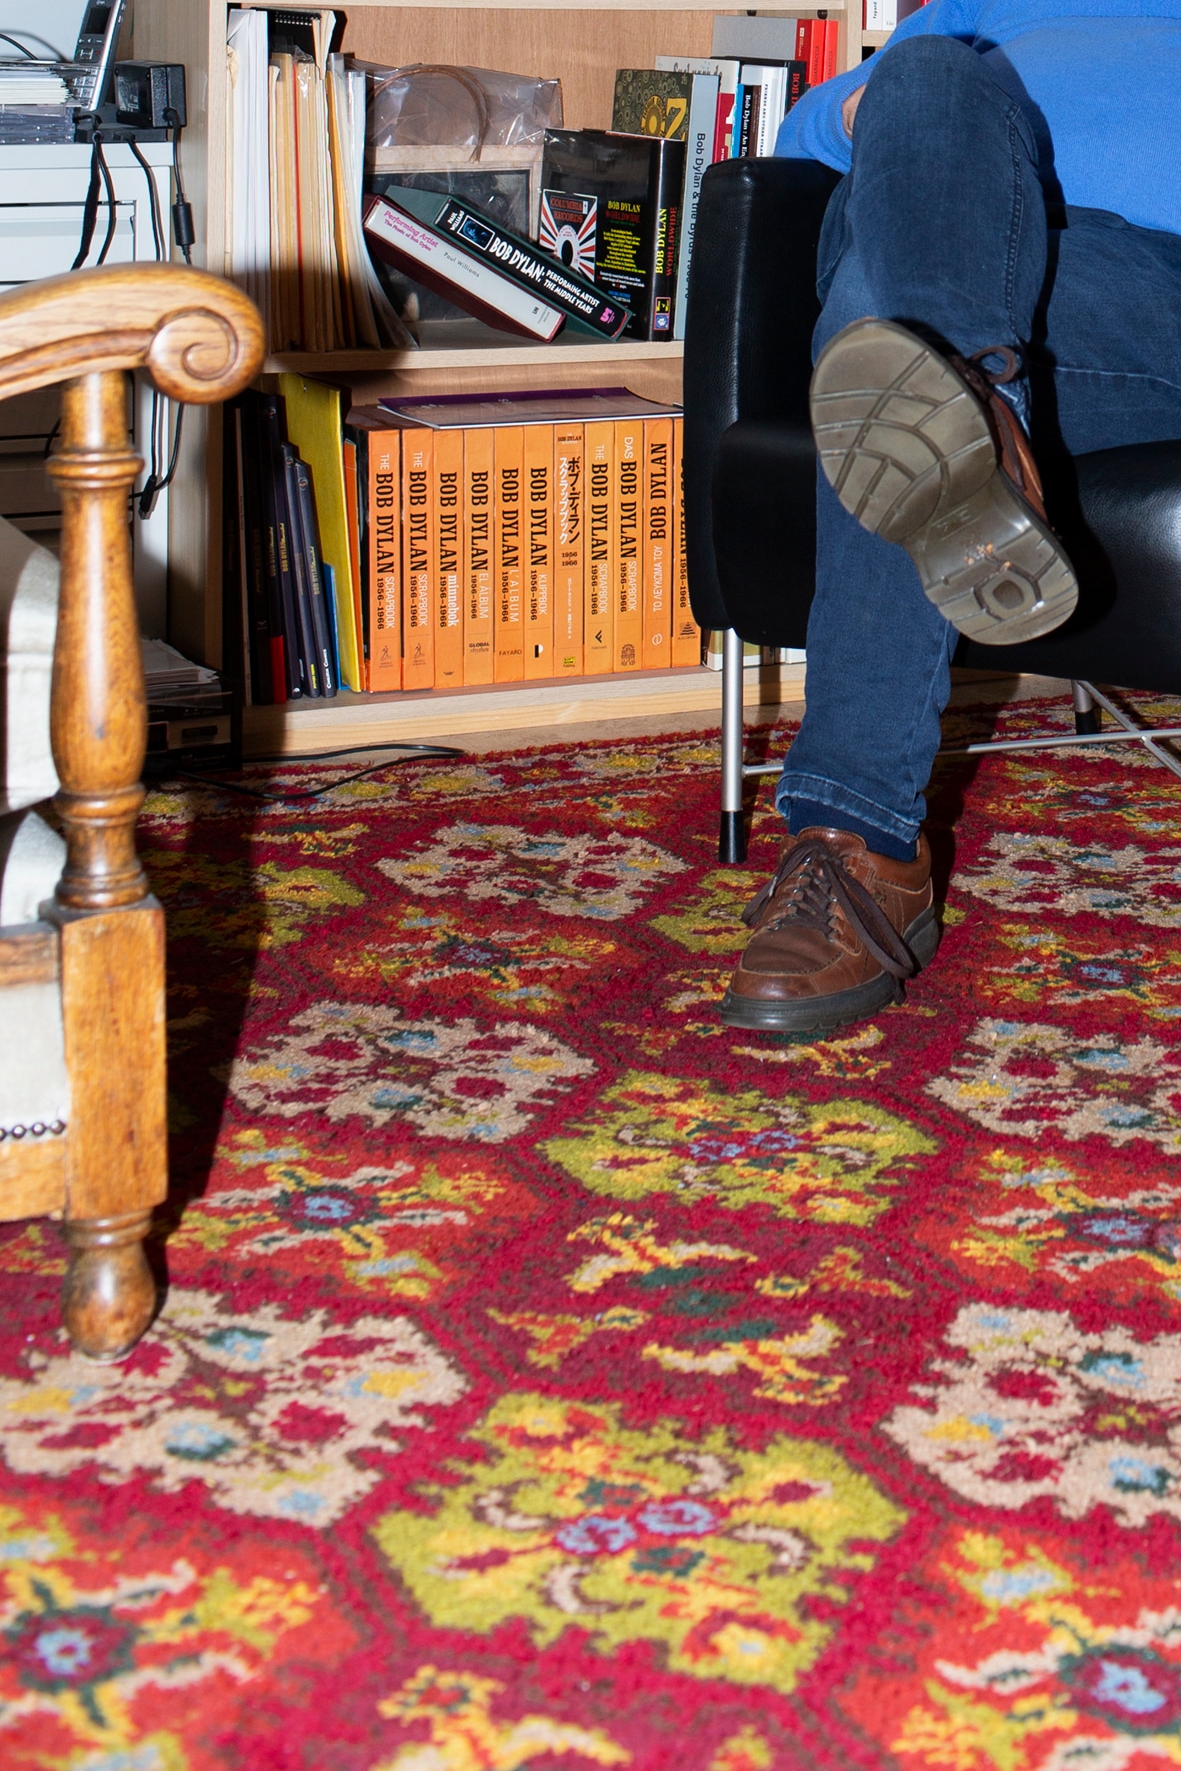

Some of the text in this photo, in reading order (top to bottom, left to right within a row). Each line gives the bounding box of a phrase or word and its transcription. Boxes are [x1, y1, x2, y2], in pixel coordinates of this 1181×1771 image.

[694, 132, 706, 189] Bob Dylan
[383, 209, 419, 239] Performing
[416, 230, 439, 249] Artist
[488, 237, 515, 261] BOB
[655, 208, 667, 274] BOB DYLAN
[666, 206, 678, 276] WORLDWIDE
[546, 269, 581, 297] PERFORMING
[579, 291, 600, 308] ARTIST
[375, 453, 395, 574] THE BOB DYLAN
[568, 456, 581, 545] ボブ・ディラン
[620, 436, 638, 559] DAS BOB DYLAN
[650, 442, 667, 540] BOB DYLAN
[384, 576, 396, 630] SCRAPBOOK
[446, 574, 458, 627] minnebok
[499, 649, 523, 657] FAYARD
